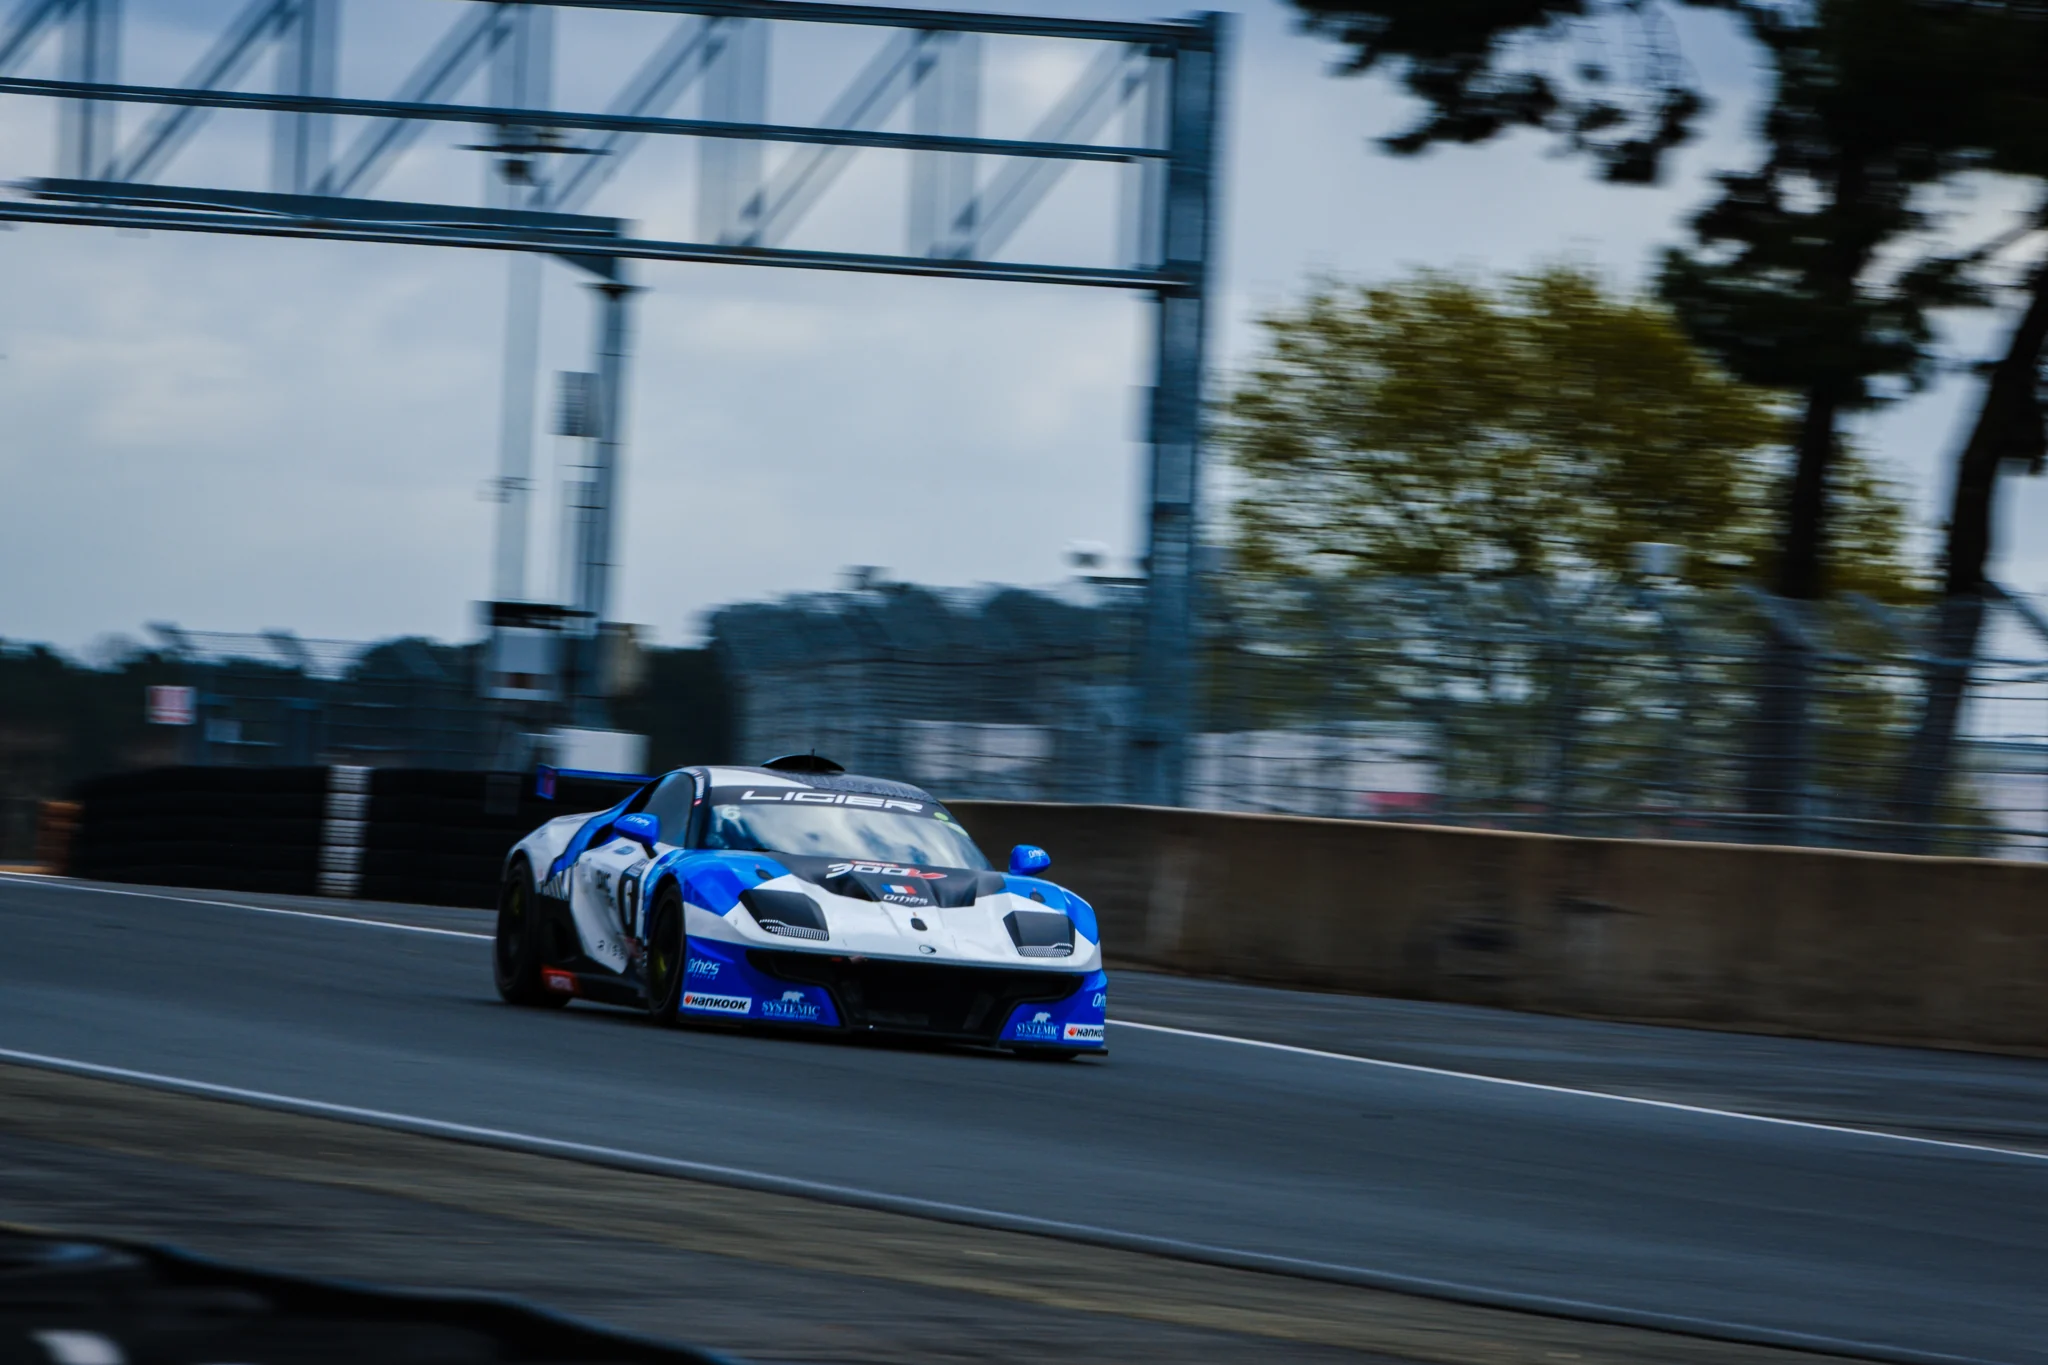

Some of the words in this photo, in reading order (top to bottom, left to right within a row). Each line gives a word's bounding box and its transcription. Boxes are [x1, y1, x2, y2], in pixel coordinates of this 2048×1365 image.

[741, 790, 923, 813] LIGIER
[721, 806, 741, 820] 6
[761, 1000, 821, 1017] SYSTEMIC
[1015, 1022, 1060, 1036] SYSTEMIC
